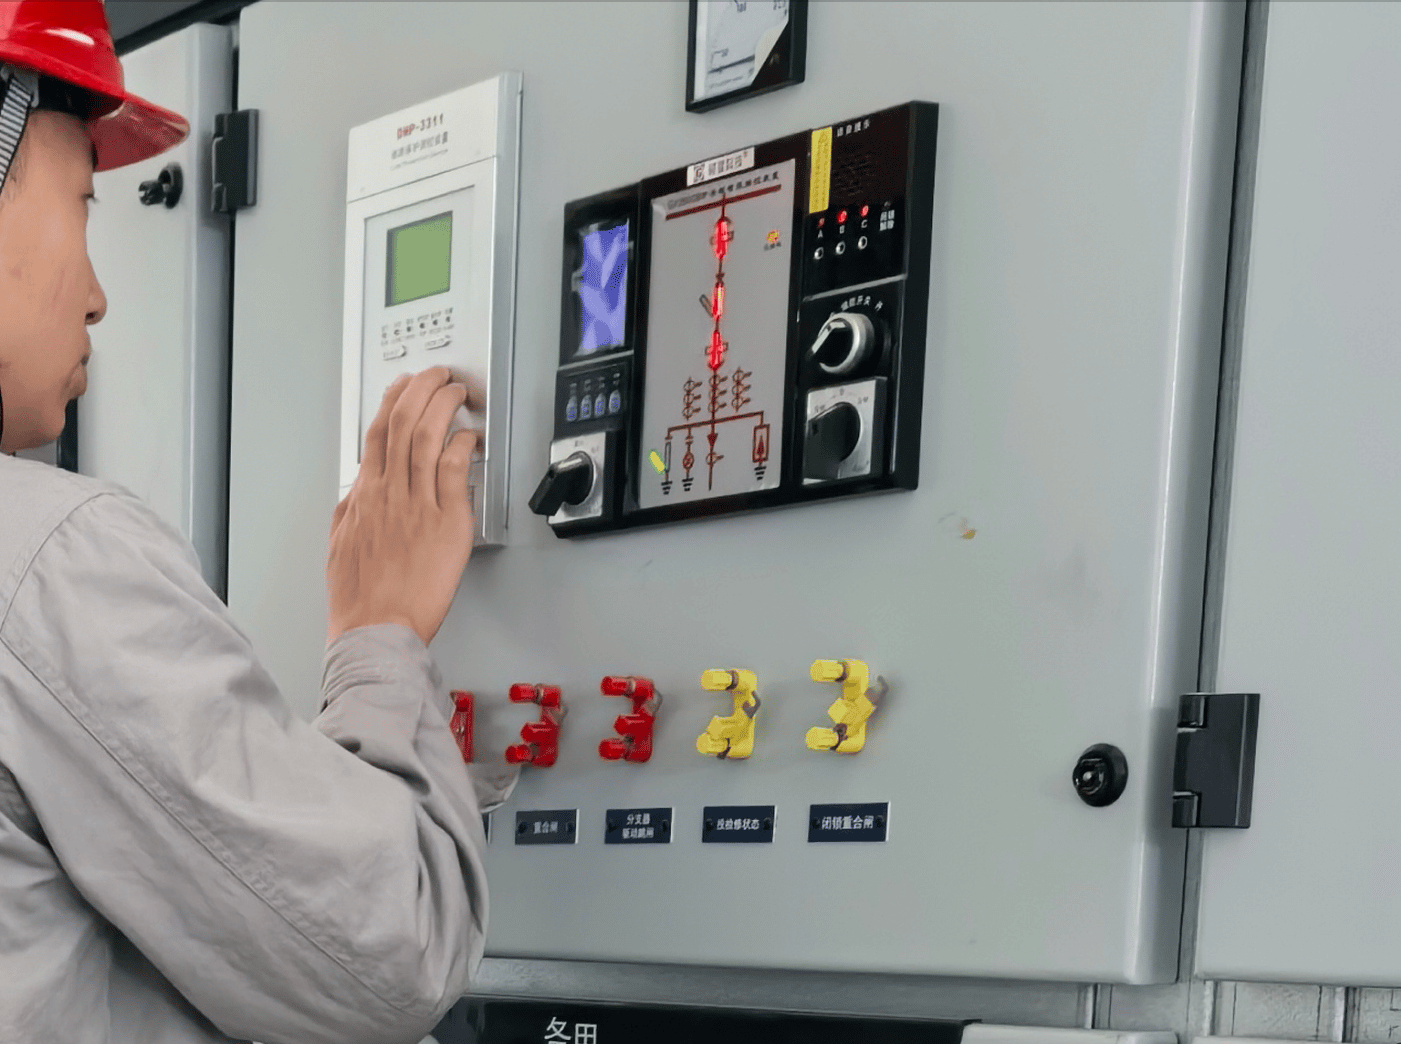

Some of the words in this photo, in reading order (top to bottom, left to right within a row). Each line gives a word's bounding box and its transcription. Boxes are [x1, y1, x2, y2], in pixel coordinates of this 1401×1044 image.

[821, 814, 875, 831] 闭锁重合闸
